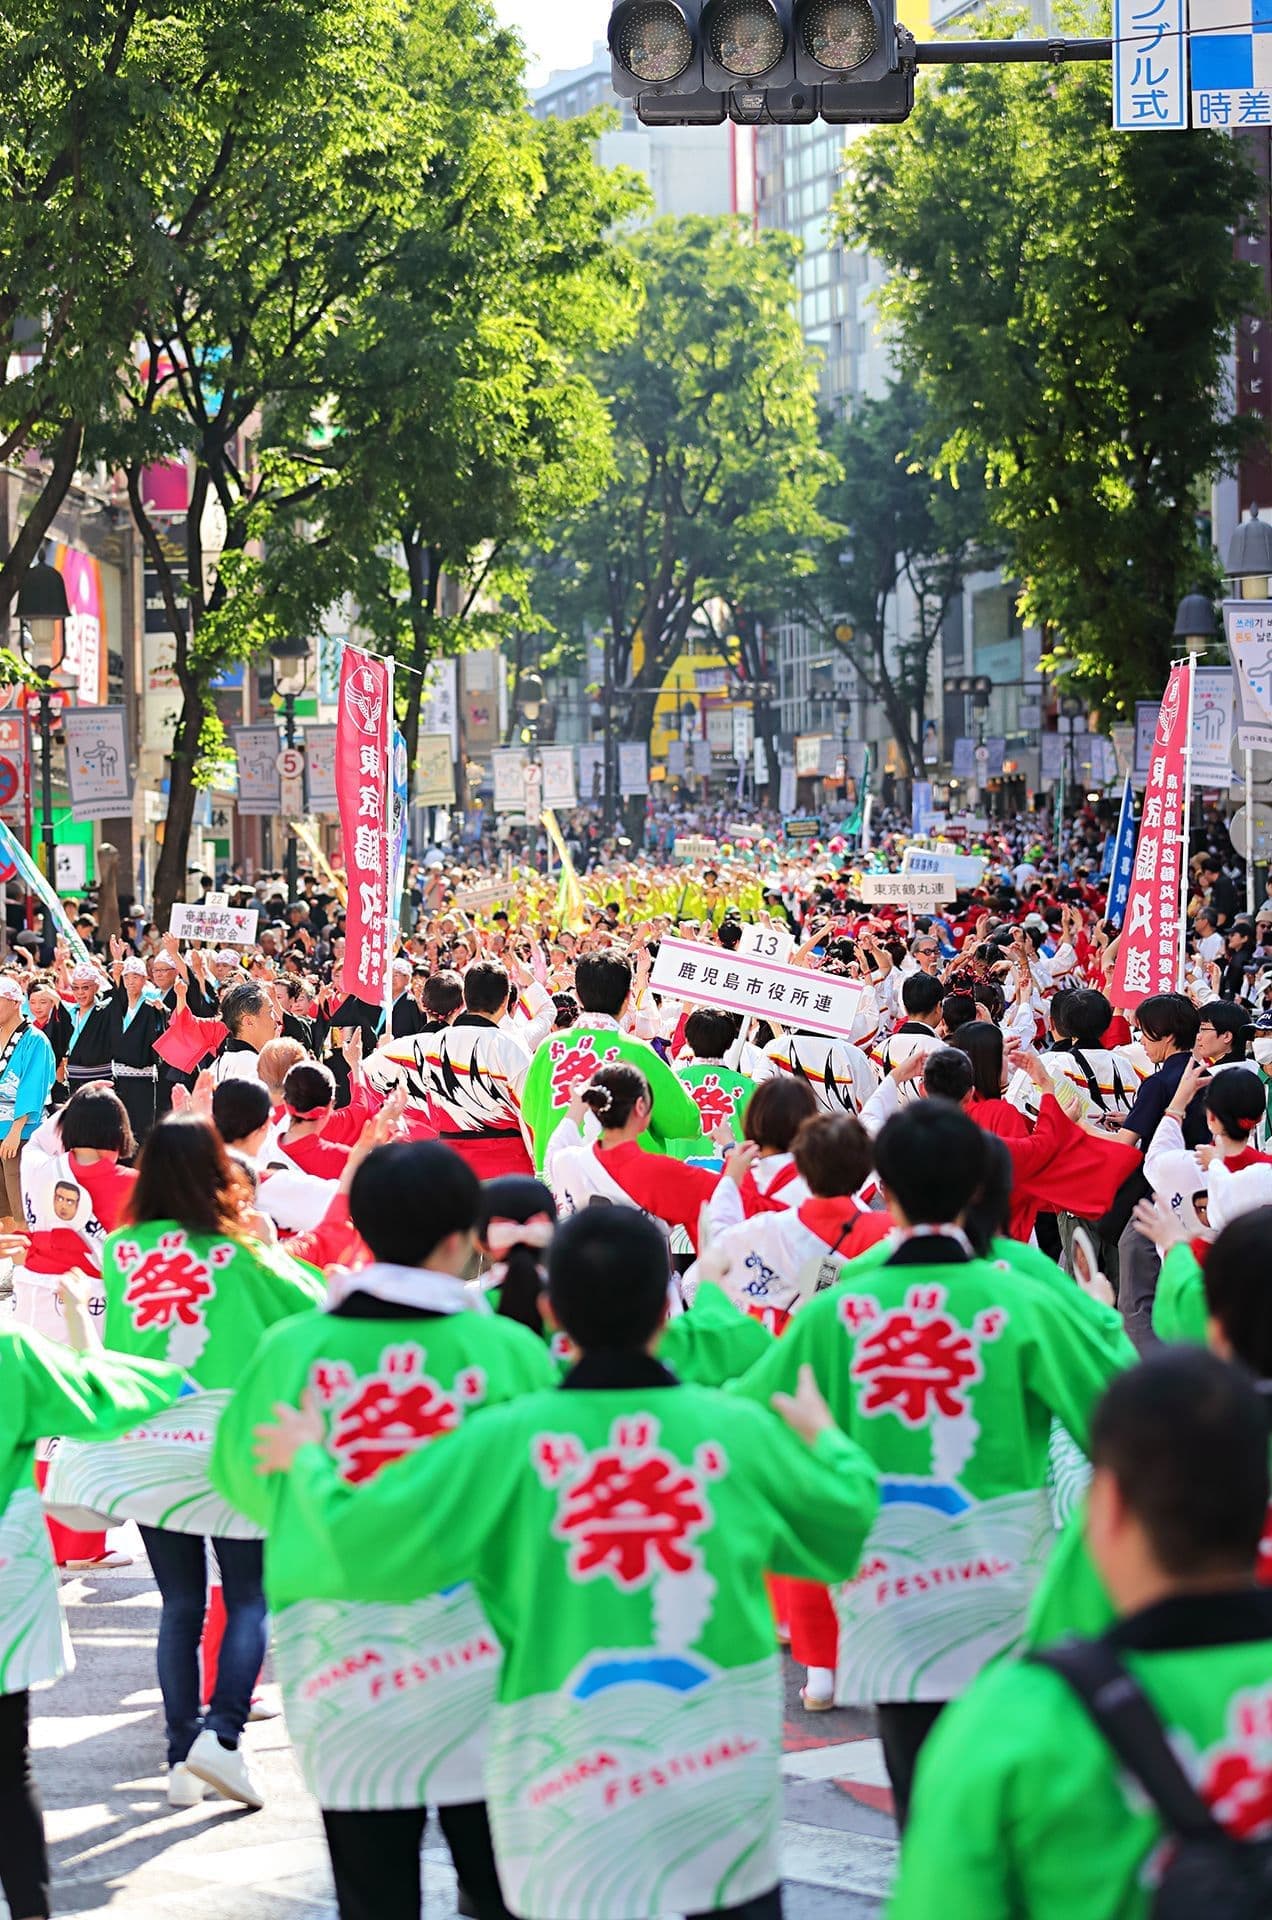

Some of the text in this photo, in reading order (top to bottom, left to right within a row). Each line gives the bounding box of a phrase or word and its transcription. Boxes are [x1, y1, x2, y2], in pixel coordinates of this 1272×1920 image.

[1200, 91, 1271, 125] 時差
[284, 754, 297, 773] 5
[528, 769, 537, 781] 7
[211, 895, 223, 904] 22
[873, 882, 945, 896] 東京鶴丸連
[185, 910, 231, 926] 奄美高校
[181, 924, 238, 941] 関東同窓会
[752, 933, 779, 956] 13
[678, 961, 833, 1013] 鹿児島市役所連
[550, 1037, 618, 1060] おはら
[128, 1252, 210, 1326] 祭
[855, 1314, 978, 1421] 祭
[123, 1429, 212, 1444] ESTIVAL
[561, 1453, 706, 1581] 祭
[877, 1556, 1012, 1605] FESTIVAL
[370, 1637, 498, 1701] FESTIVA
[602, 1736, 761, 1808] FESTIVAL
